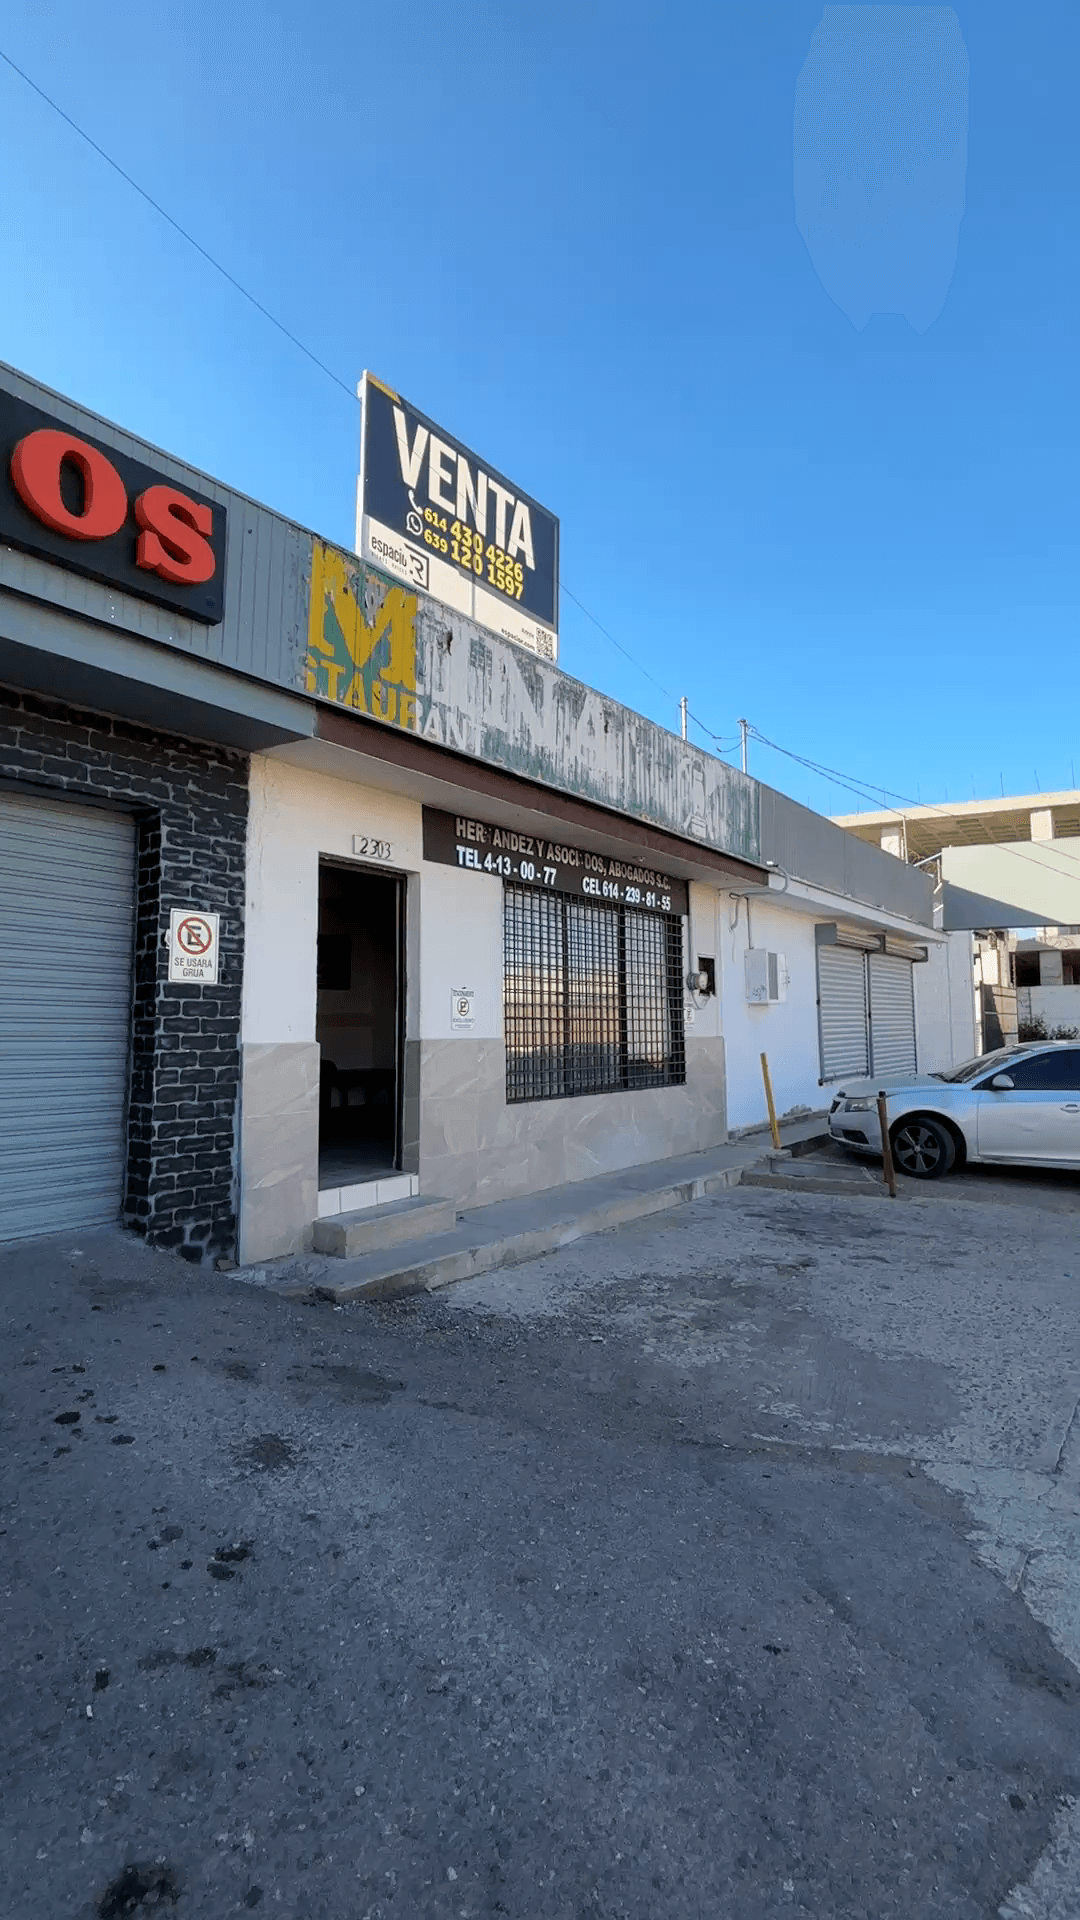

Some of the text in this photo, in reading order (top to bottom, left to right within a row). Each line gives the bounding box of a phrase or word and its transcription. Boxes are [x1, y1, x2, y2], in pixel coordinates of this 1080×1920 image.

[11, 428, 216, 585] OS
[393, 405, 535, 571] VENTA
[424, 507, 523, 583] 614 430 4226
[424, 529, 449, 553] 639
[451, 540, 483, 576] 120
[487, 563, 523, 600] 1597
[360, 837, 391, 860] 2303
[456, 817, 534, 856] HERANDEZ
[536, 839, 545, 858] Y
[546, 842, 608, 877] ASOCIDOS,
[608, 860, 655, 886] ABOGADOS
[456, 844, 482, 870] TEL
[582, 875, 601, 896] CEL
[174, 957, 185, 967] SE
[182, 967, 205, 978] GRUA
